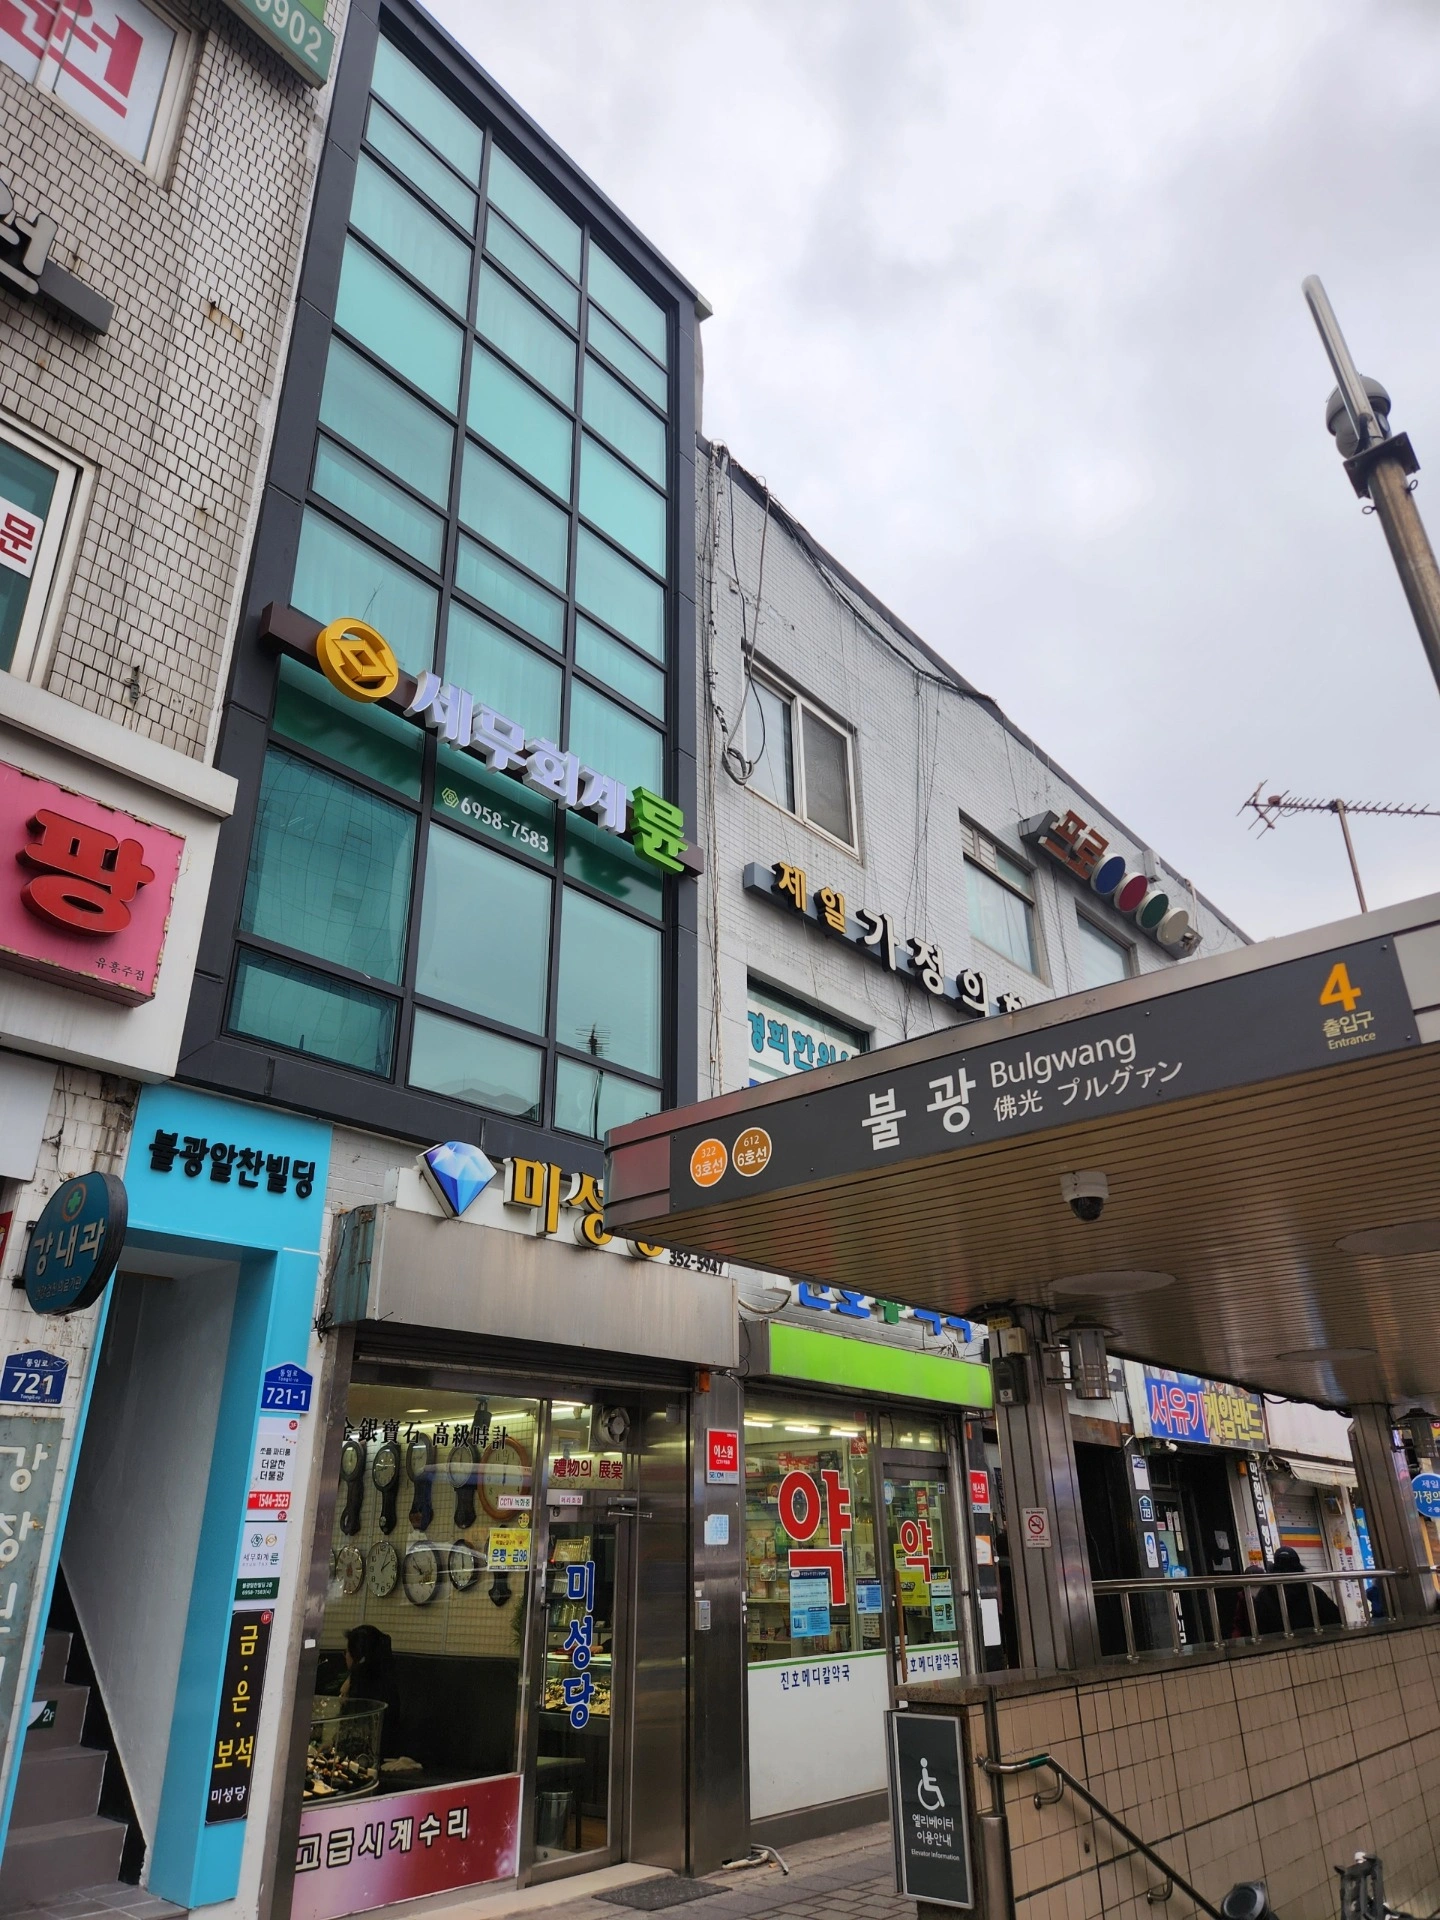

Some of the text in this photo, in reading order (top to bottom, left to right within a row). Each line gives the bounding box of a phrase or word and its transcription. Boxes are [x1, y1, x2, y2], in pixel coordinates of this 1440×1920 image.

[404, 670, 689, 875] 세무회계 륜
[460, 796, 549, 853] 6958-7583
[22, 808, 156, 935] 팡
[95, 957, 145, 981] 유흥주점
[1319, 962, 1361, 1012] 4
[1322, 1010, 1375, 1038] 출입구
[1328, 1032, 1376, 1050] Entrance
[989, 1033, 1137, 1088] Bulgwang
[993, 1061, 1183, 1122] 佛光 プルグァン
[743, 1135, 760, 1147] 612
[701, 1146, 717, 1158] 322
[737, 1146, 767, 1167] 6호선
[149, 1129, 316, 1199] 불광알찬빌딩
[695, 1157, 723, 1178] 3호선
[503, 1156, 664, 1258] 미성
[33, 1218, 106, 1276] 강내과
[26, 1358, 49, 1368] 통일로
[279, 1369, 299, 1377] 통일로
[11, 1372, 54, 1395] 721
[266, 1387, 307, 1406] 721-1
[289, 1421, 297, 1429] 3F
[432, 1421, 509, 1449] 高級時計
[713, 1444, 733, 1458] 에스원
[261, 1459, 286, 1469] 더알찬
[259, 1470, 285, 1481] 더불광
[499, 1497, 513, 1506] CCTV
[778, 1469, 852, 1606] 약
[243, 1552, 280, 1565] 세무회계 륜
[900, 1519, 933, 1584] 약
[563, 1560, 596, 1729] 미성당
[906, 1653, 959, 1675] 호메디칼약국
[780, 1664, 850, 1690] 진호메디칼약국
[42, 1709, 55, 1722] 2F
[210, 1785, 247, 1805] 미성당
[912, 1813, 954, 1831] 엘리베이터
[295, 1805, 470, 1873] 고급시계수리
[916, 1830, 952, 1847] 이용안내
[911, 1848, 960, 1861] Elevator Information
